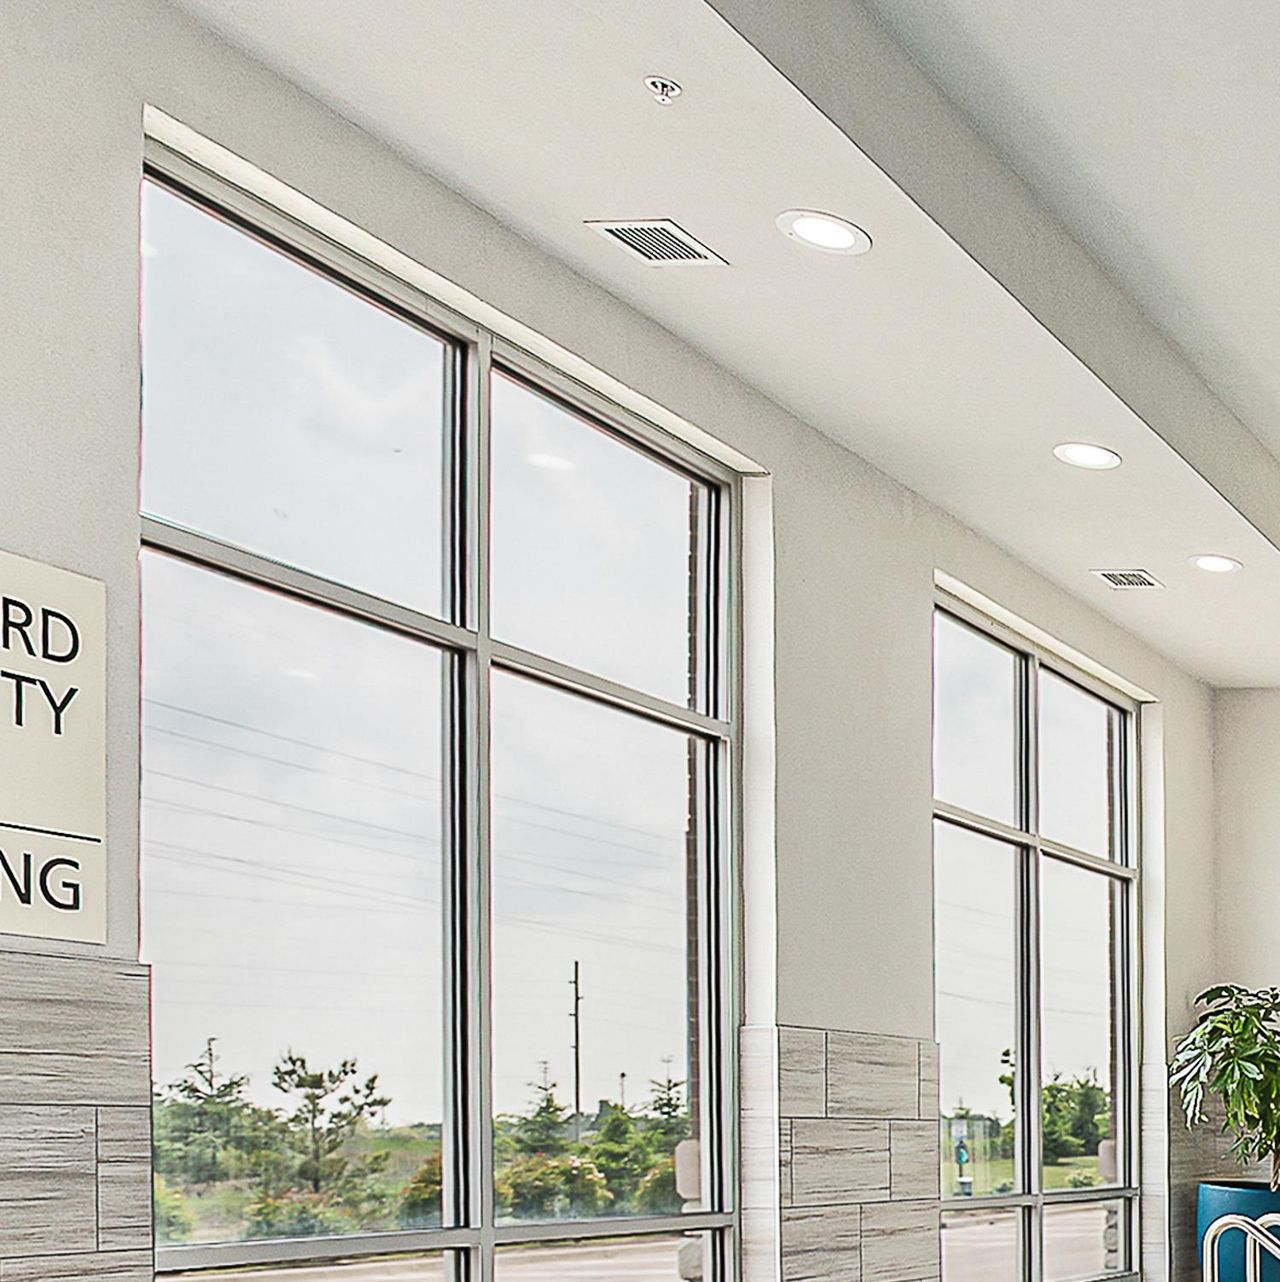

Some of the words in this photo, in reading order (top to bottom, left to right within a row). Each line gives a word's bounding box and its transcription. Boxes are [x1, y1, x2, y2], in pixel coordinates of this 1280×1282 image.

[1, 597, 80, 663] RD
[0, 670, 79, 735] TY
[0, 849, 80, 911] NG
